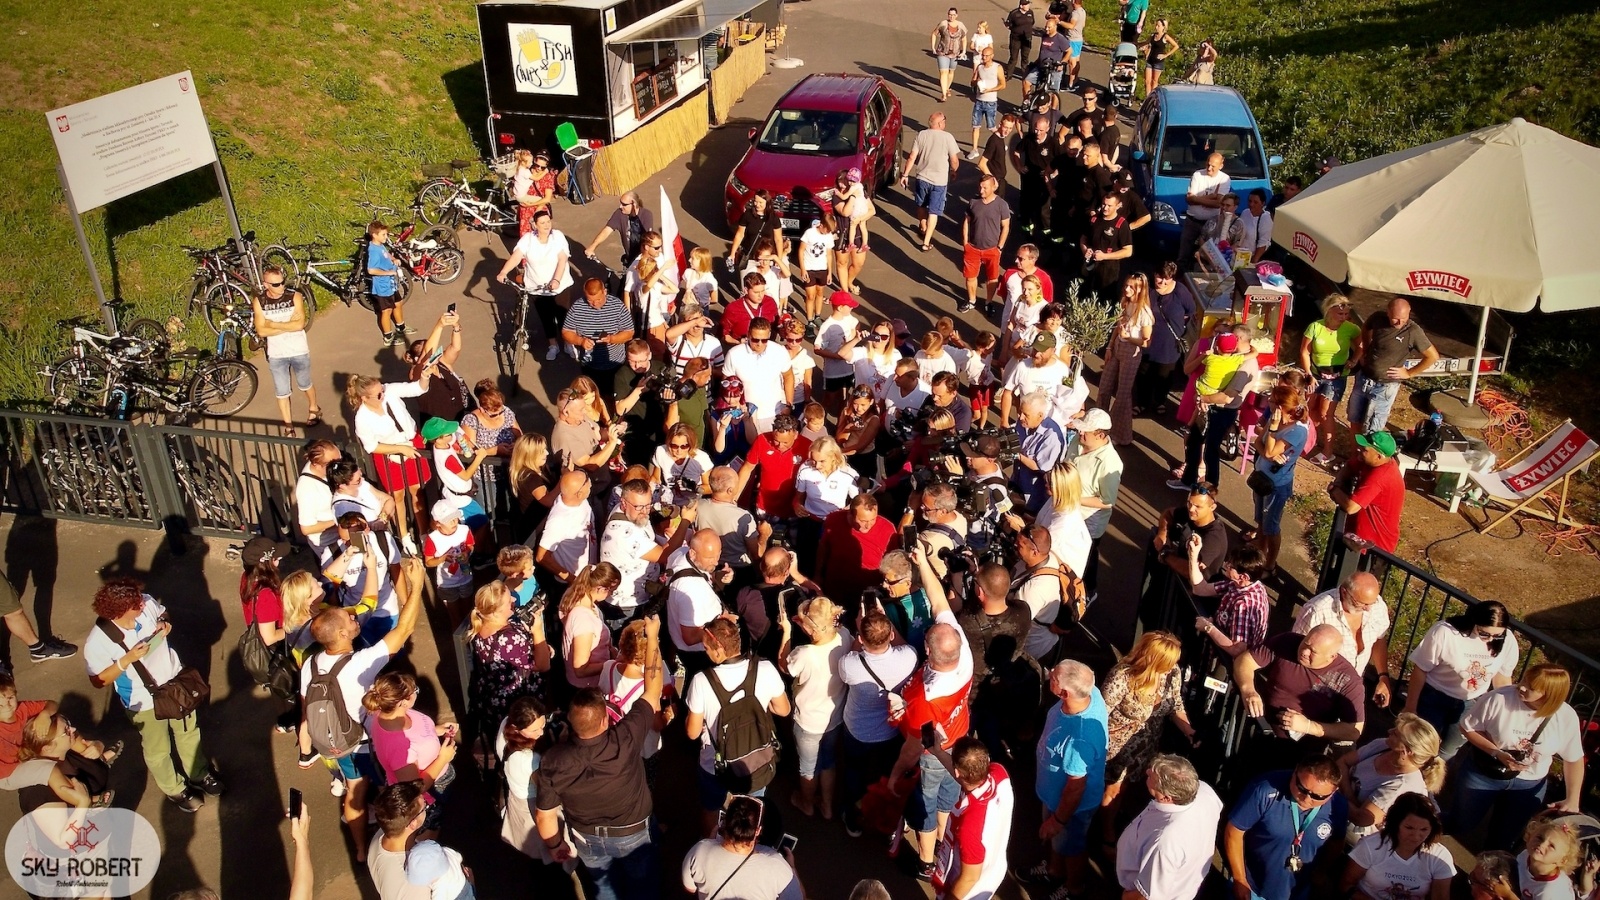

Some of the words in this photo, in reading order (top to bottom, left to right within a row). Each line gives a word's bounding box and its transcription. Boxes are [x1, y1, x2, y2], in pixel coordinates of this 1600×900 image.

[1413, 270, 1465, 291] ŻYWIEC
[264, 299, 292, 310] ENJOY
[1514, 440, 1578, 489] ŻYWIEC
